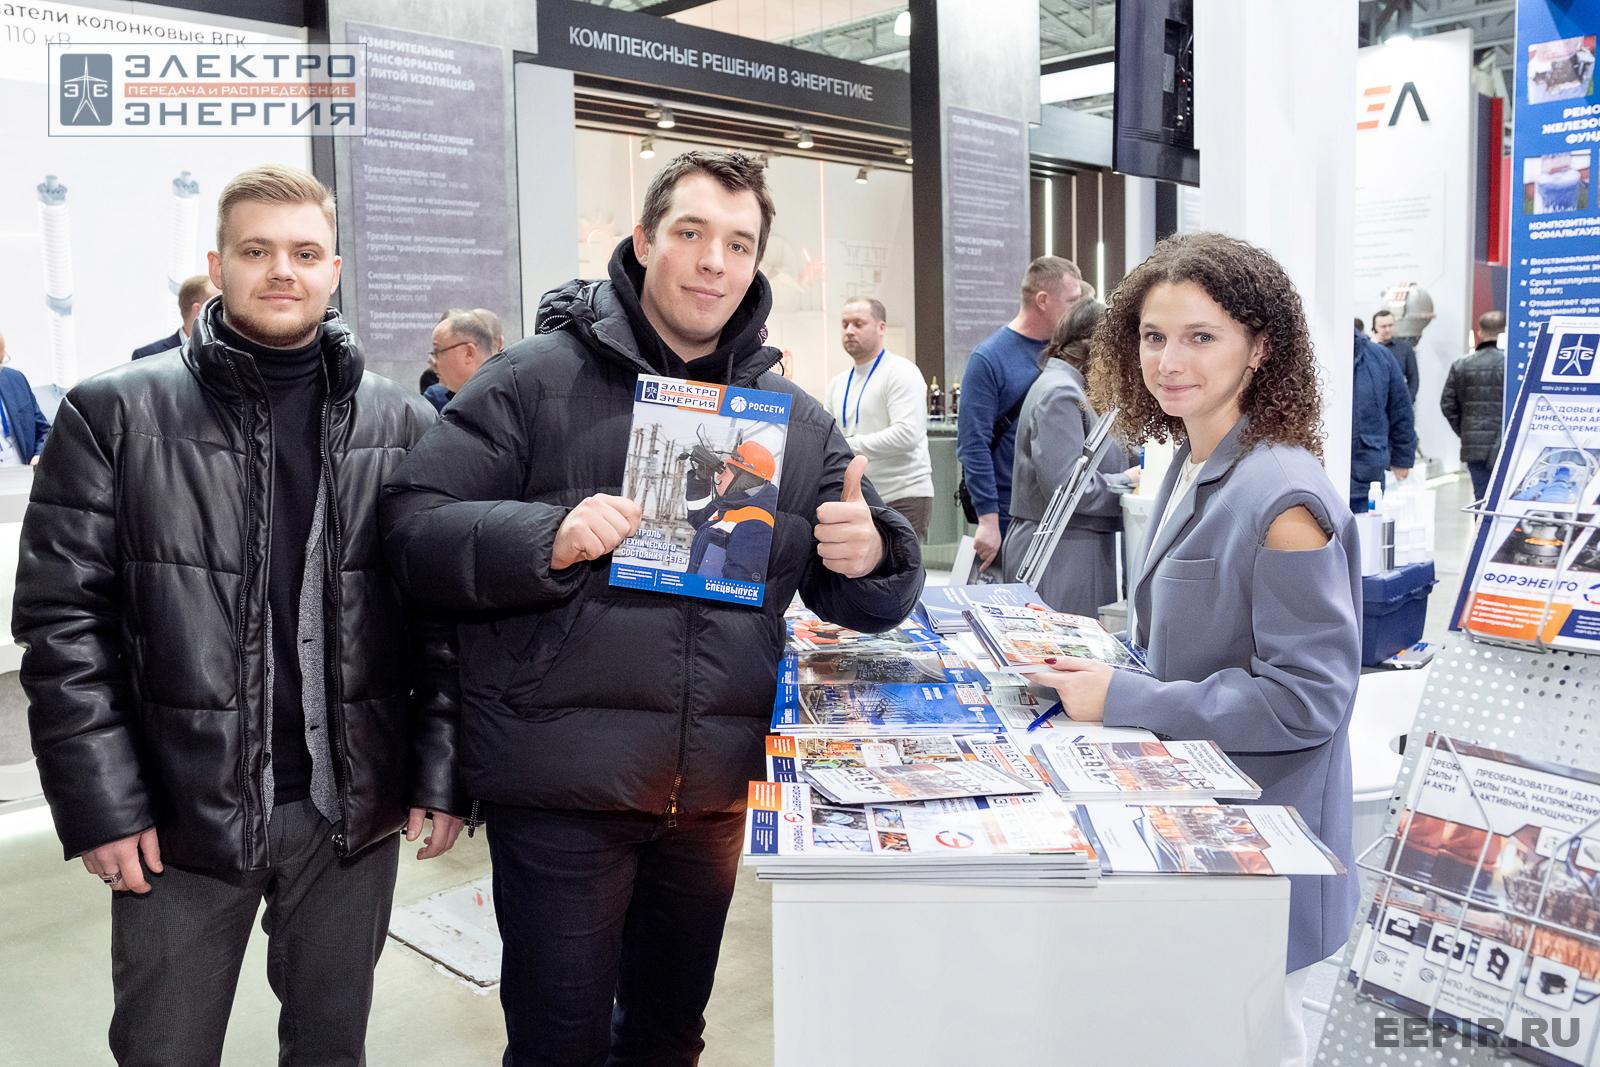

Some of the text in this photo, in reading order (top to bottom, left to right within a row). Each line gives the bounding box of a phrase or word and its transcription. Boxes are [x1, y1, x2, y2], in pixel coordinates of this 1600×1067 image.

[6, 24, 36, 45] 110
[77, 15, 205, 43] колонковые
[212, 31, 247, 48] ВГК
[358, 35, 455, 60] ИЗМЕРИТЕЛЬНЫЕ
[360, 51, 462, 75] ТРАНСФОРМАТОРЫ
[569, 26, 874, 102] КОМПЛЕКСНЫЕ РЕШЕНИЯ В ЭНЕРГЕТИКЕ
[370, 67, 408, 82] ЛИТОЙ
[411, 73, 475, 92] ИЗОЛЯЦИЕЙ
[659, 395, 716, 409] ЭНЕРГИЯ
[661, 383, 718, 397] ЭЛЕКТРО
[748, 402, 785, 415] РОССЕТИ
[1532, 414, 1587, 422] ЛИНЕНАЯ
[1535, 405, 1597, 414] ПЕРДОВЫЕ
[635, 528, 662, 539] ТРОЛЬ
[621, 547, 663, 561] СОСТОЯНИЯ
[623, 538, 677, 552] ТЕХНИЧЕСКОГО
[705, 582, 759, 598] СПЕЦВЫПУСК
[1473, 779, 1499, 792] СИЛЫ
[1476, 769, 1568, 796] ПРЕОБРАЗОВАТЕЛИ
